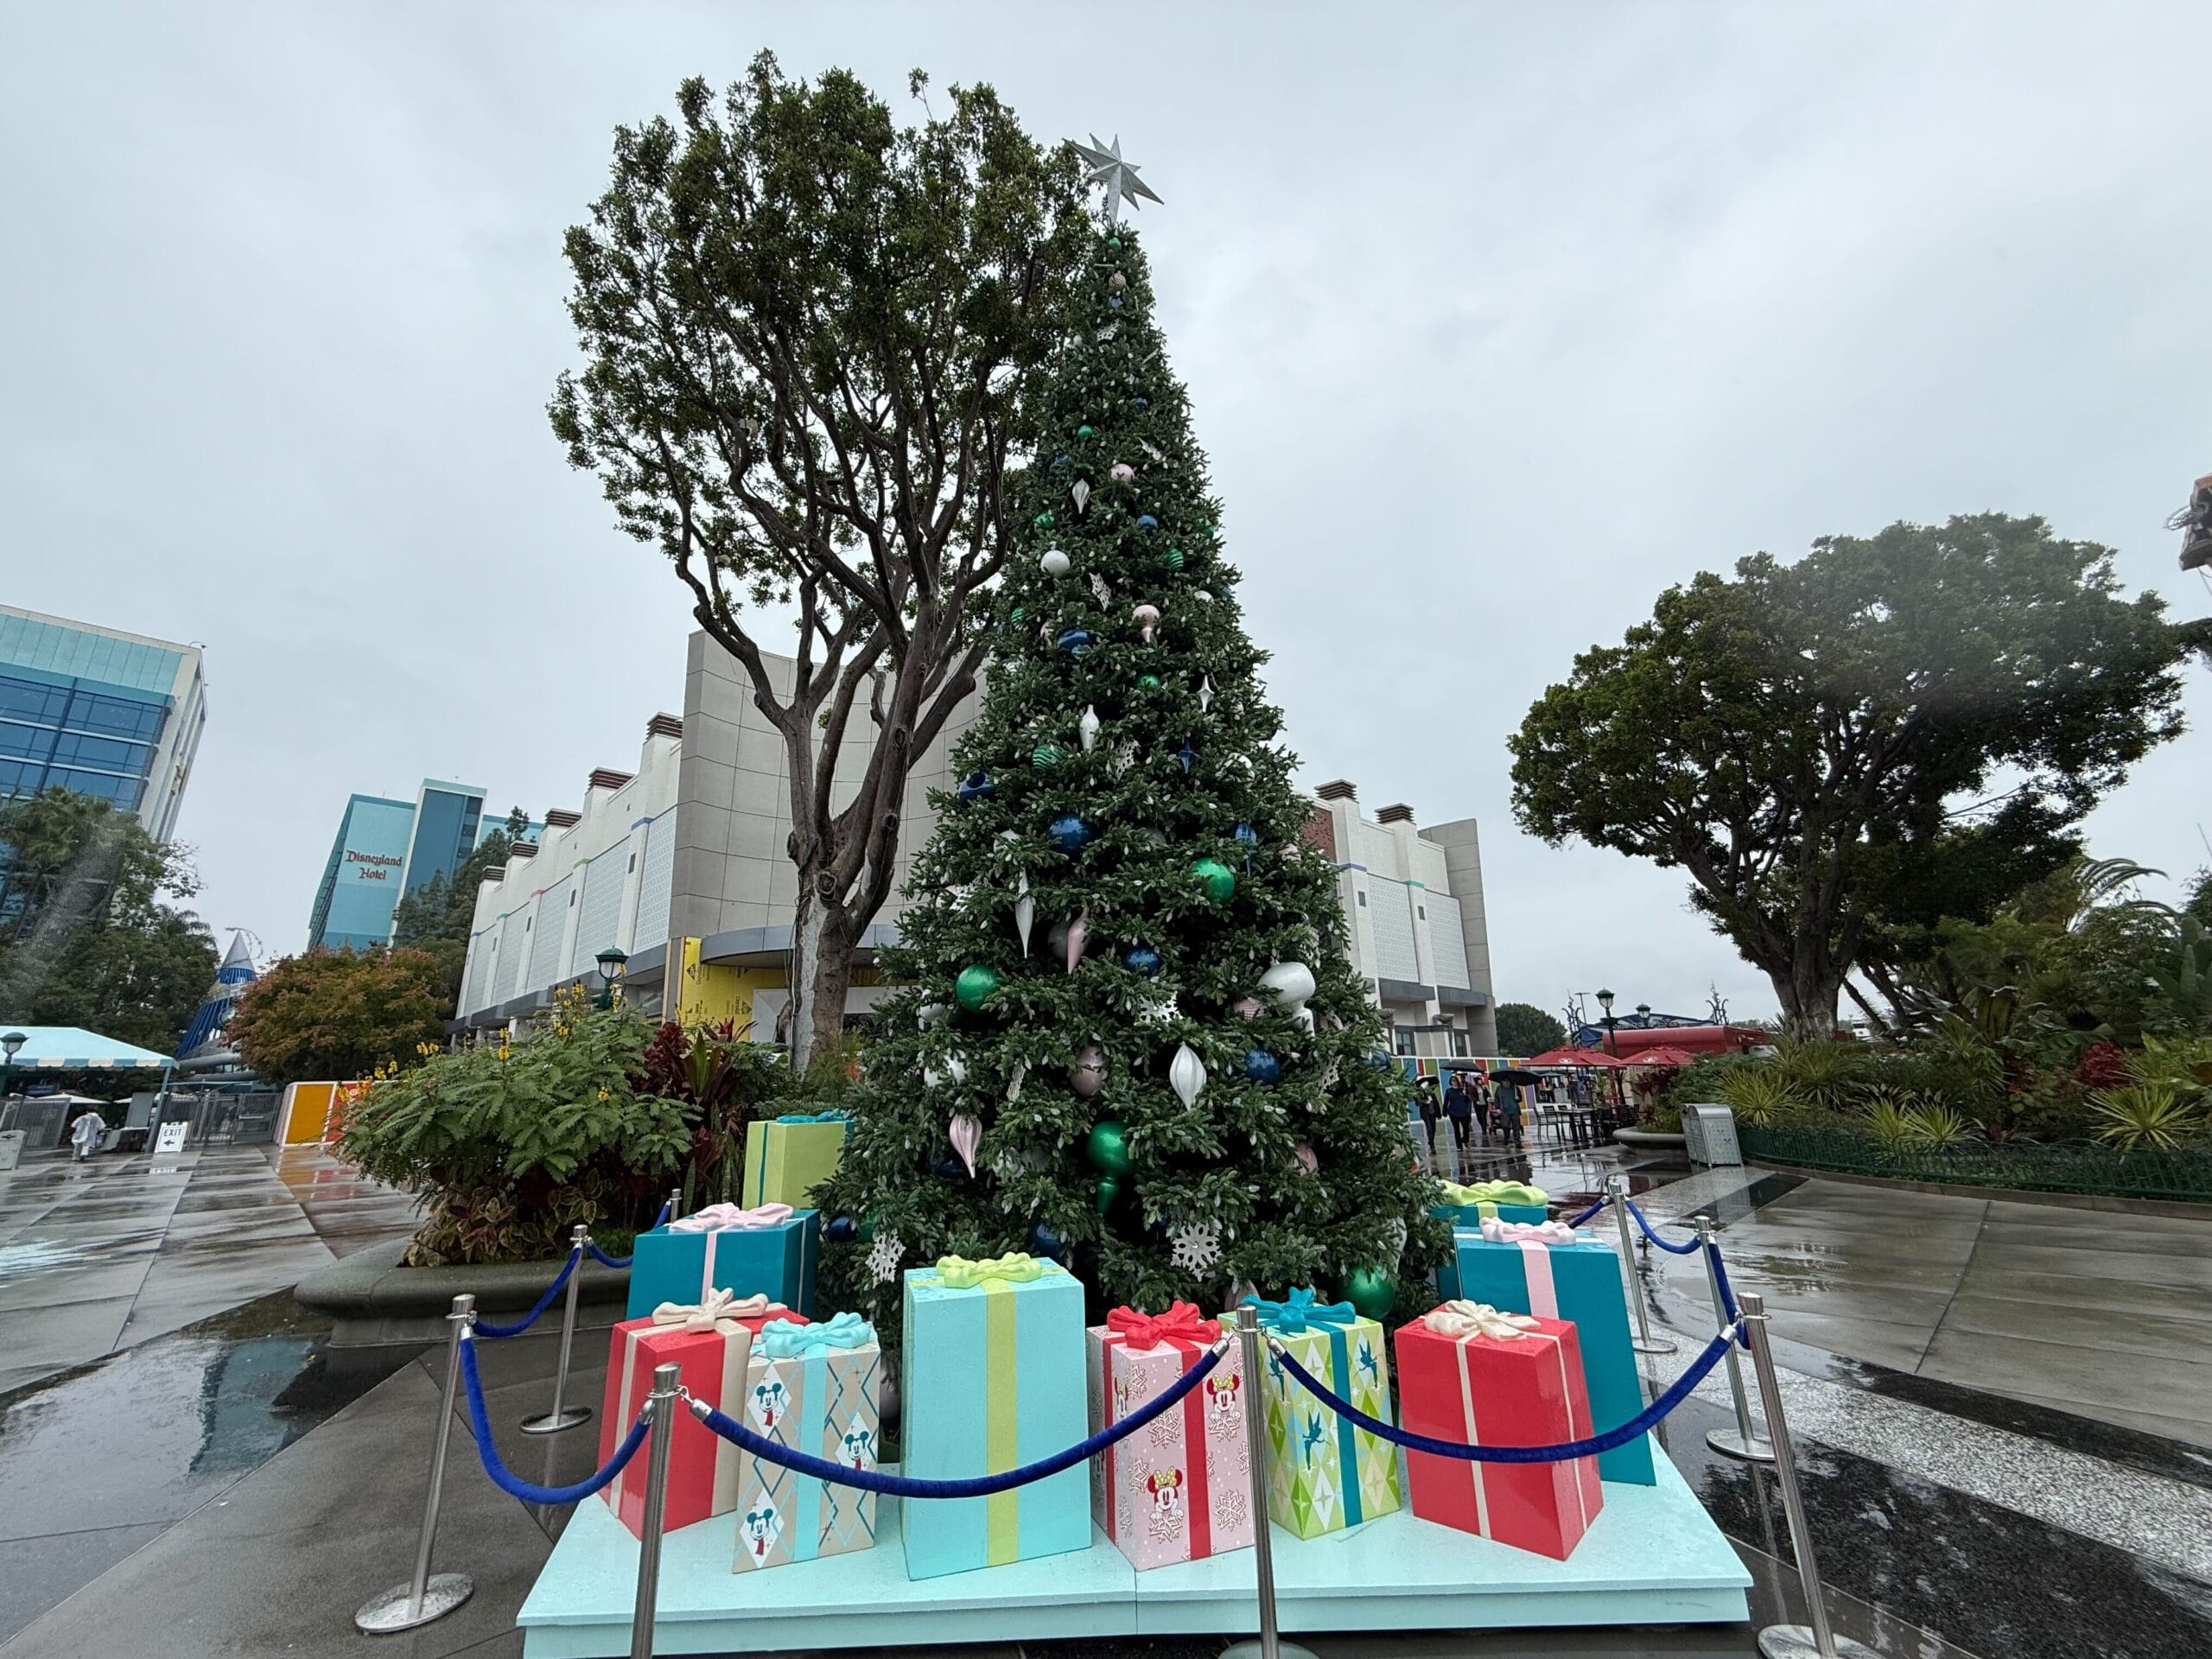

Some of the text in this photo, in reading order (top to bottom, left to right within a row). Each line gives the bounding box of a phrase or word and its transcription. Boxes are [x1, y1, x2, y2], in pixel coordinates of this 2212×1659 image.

[346, 849, 403, 867] Disneyland
[359, 867, 386, 880] Hotel
[163, 1128, 182, 1137] EXIT
